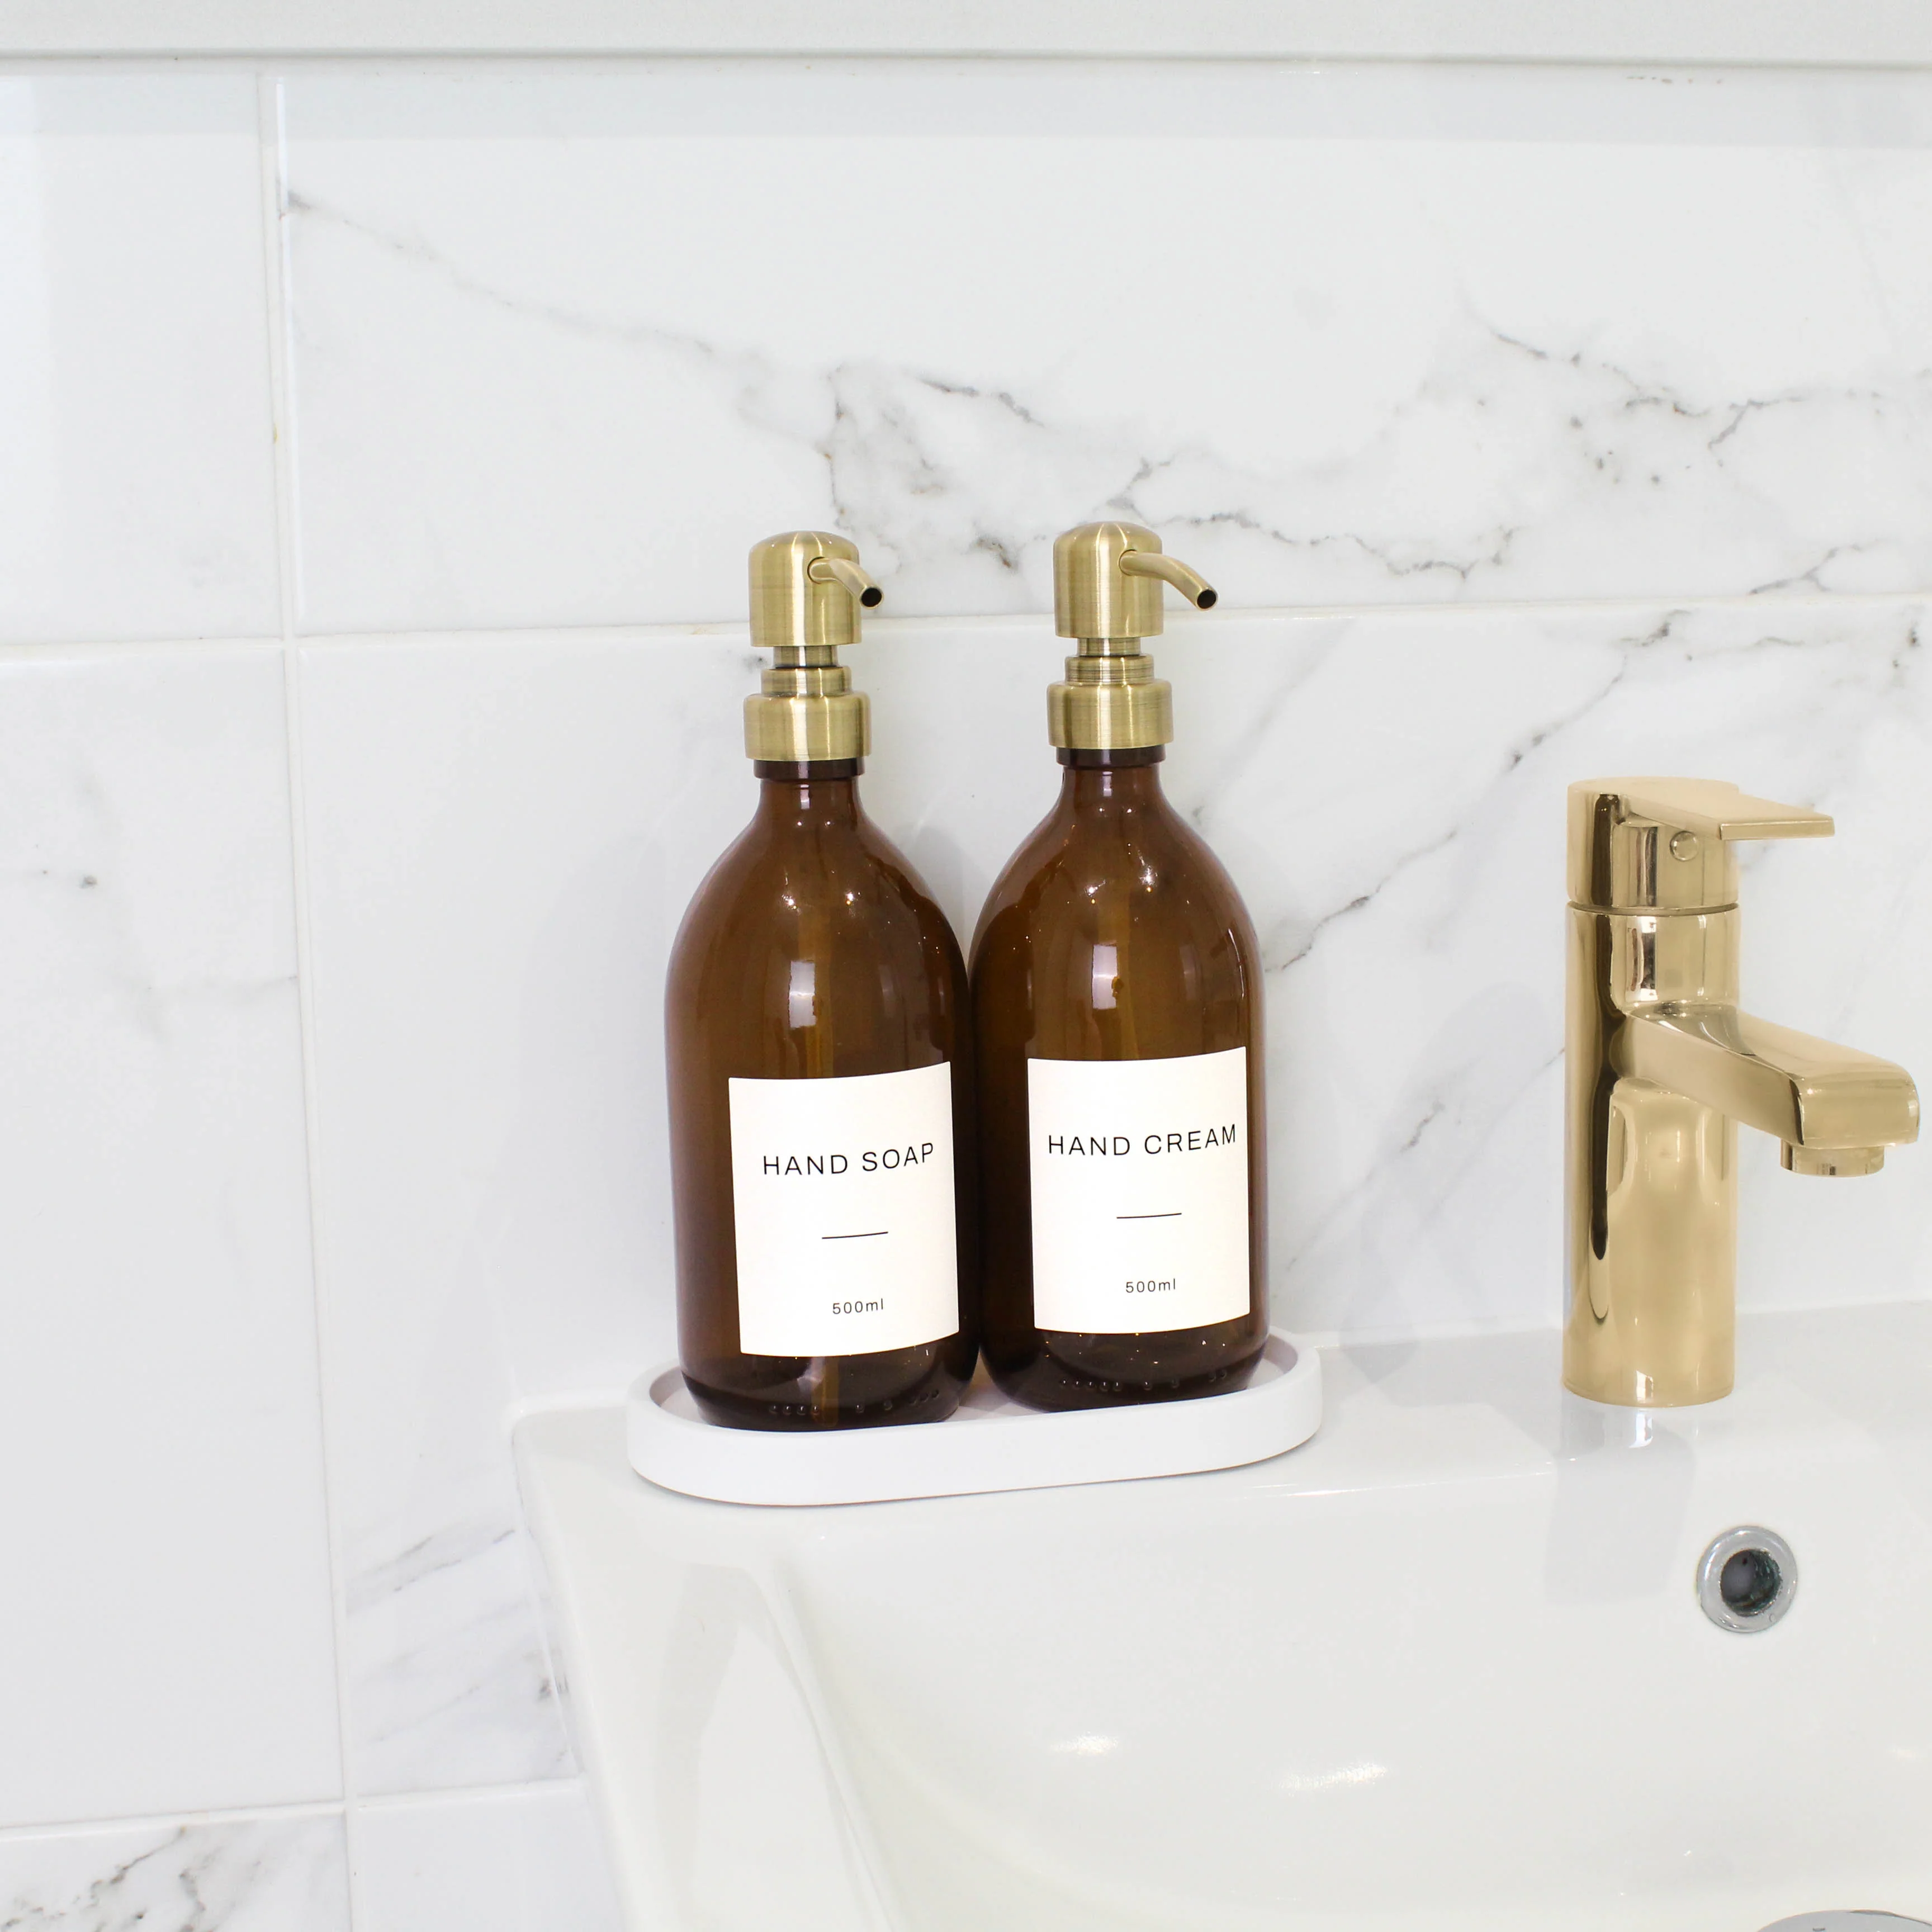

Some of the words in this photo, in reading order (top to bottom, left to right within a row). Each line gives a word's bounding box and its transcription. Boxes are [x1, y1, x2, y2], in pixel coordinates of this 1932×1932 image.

[1048, 1134, 1131, 1157] HAND
[1144, 1123, 1236, 1155] CREAM
[763, 1154, 849, 1176] HAND
[861, 1142, 934, 1172] SOAP
[1125, 1277, 1176, 1294] 500ml
[832, 1298, 884, 1315] 500ml
